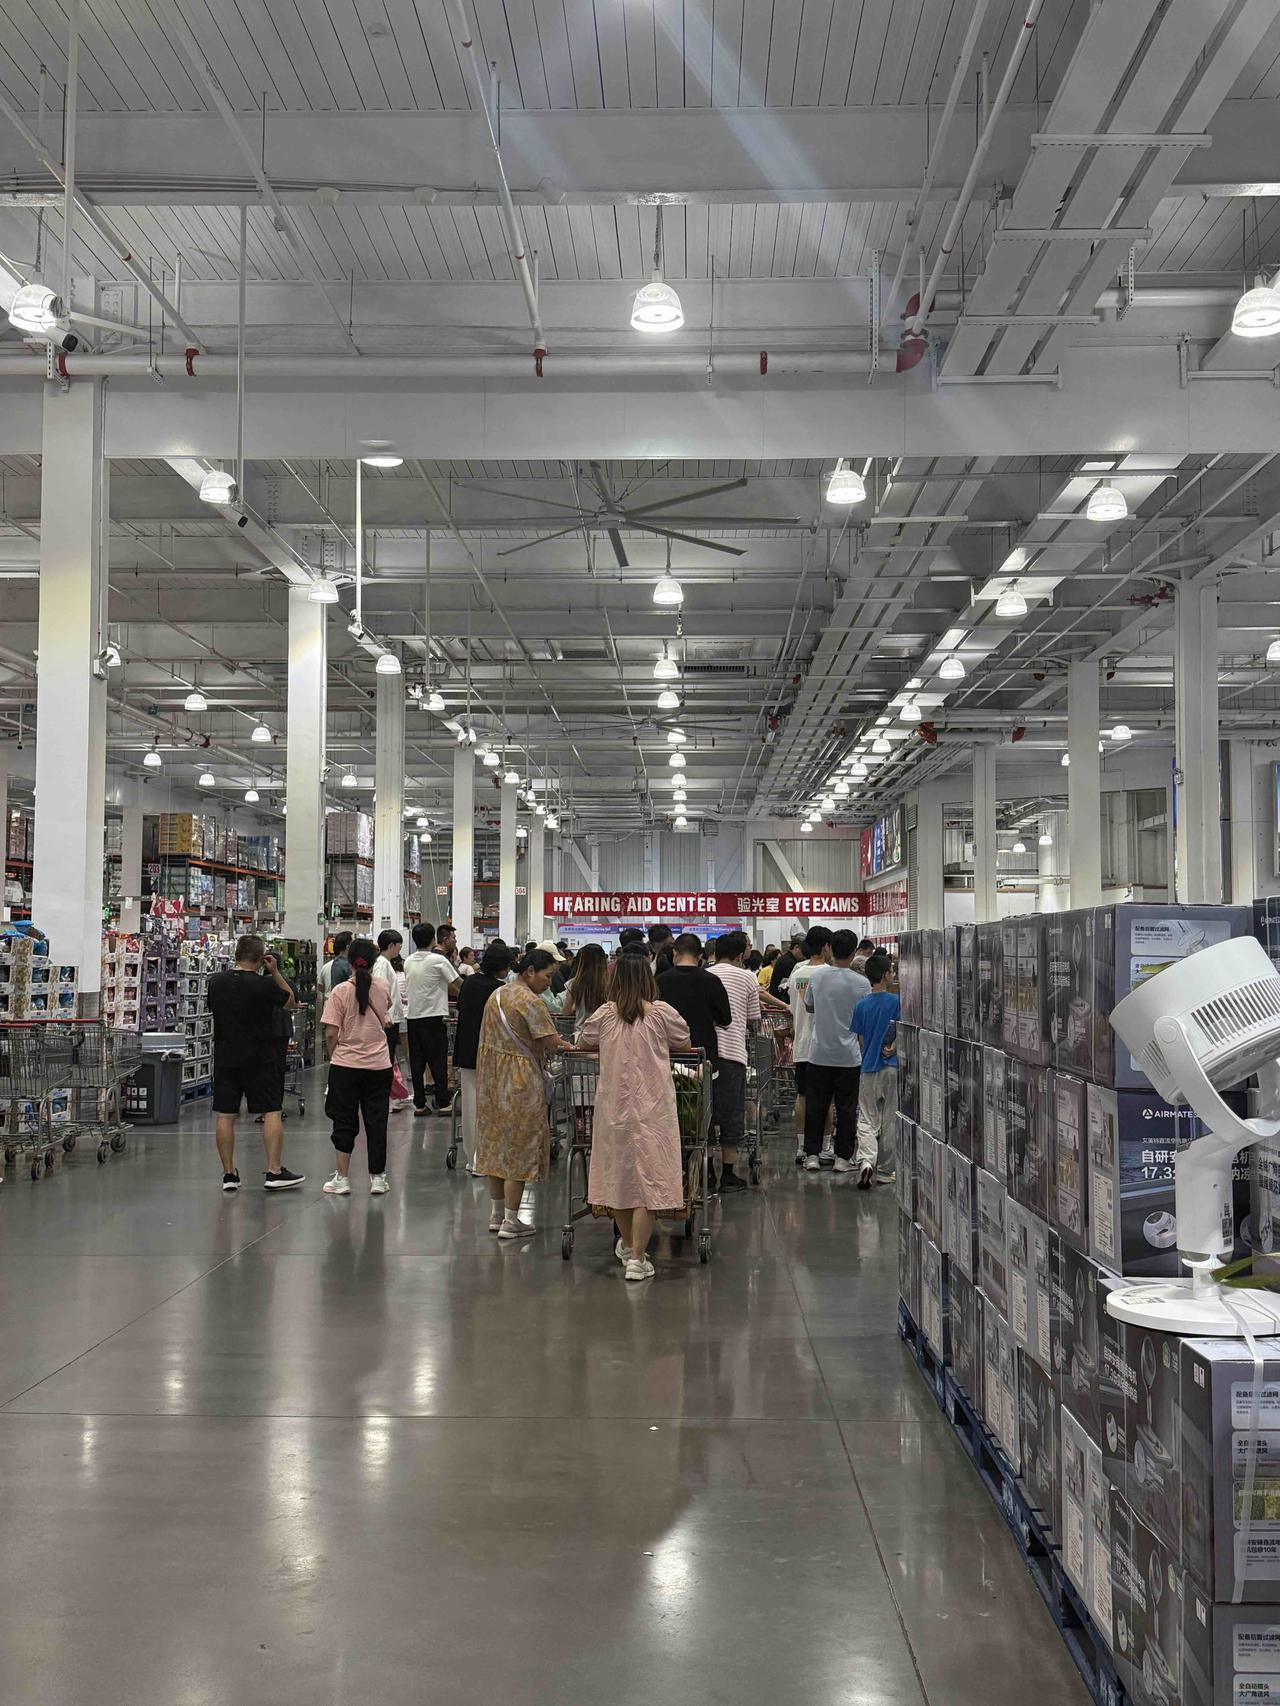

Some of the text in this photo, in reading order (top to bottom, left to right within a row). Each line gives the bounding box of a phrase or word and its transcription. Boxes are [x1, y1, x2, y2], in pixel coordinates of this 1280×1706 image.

[553, 896, 716, 912] HEARING AID CENTER
[737, 897, 780, 913] 验光室
[785, 897, 810, 912] EYE
[813, 897, 859, 912] EXAMS
[1154, 1110, 1193, 1118] AIRMATE
